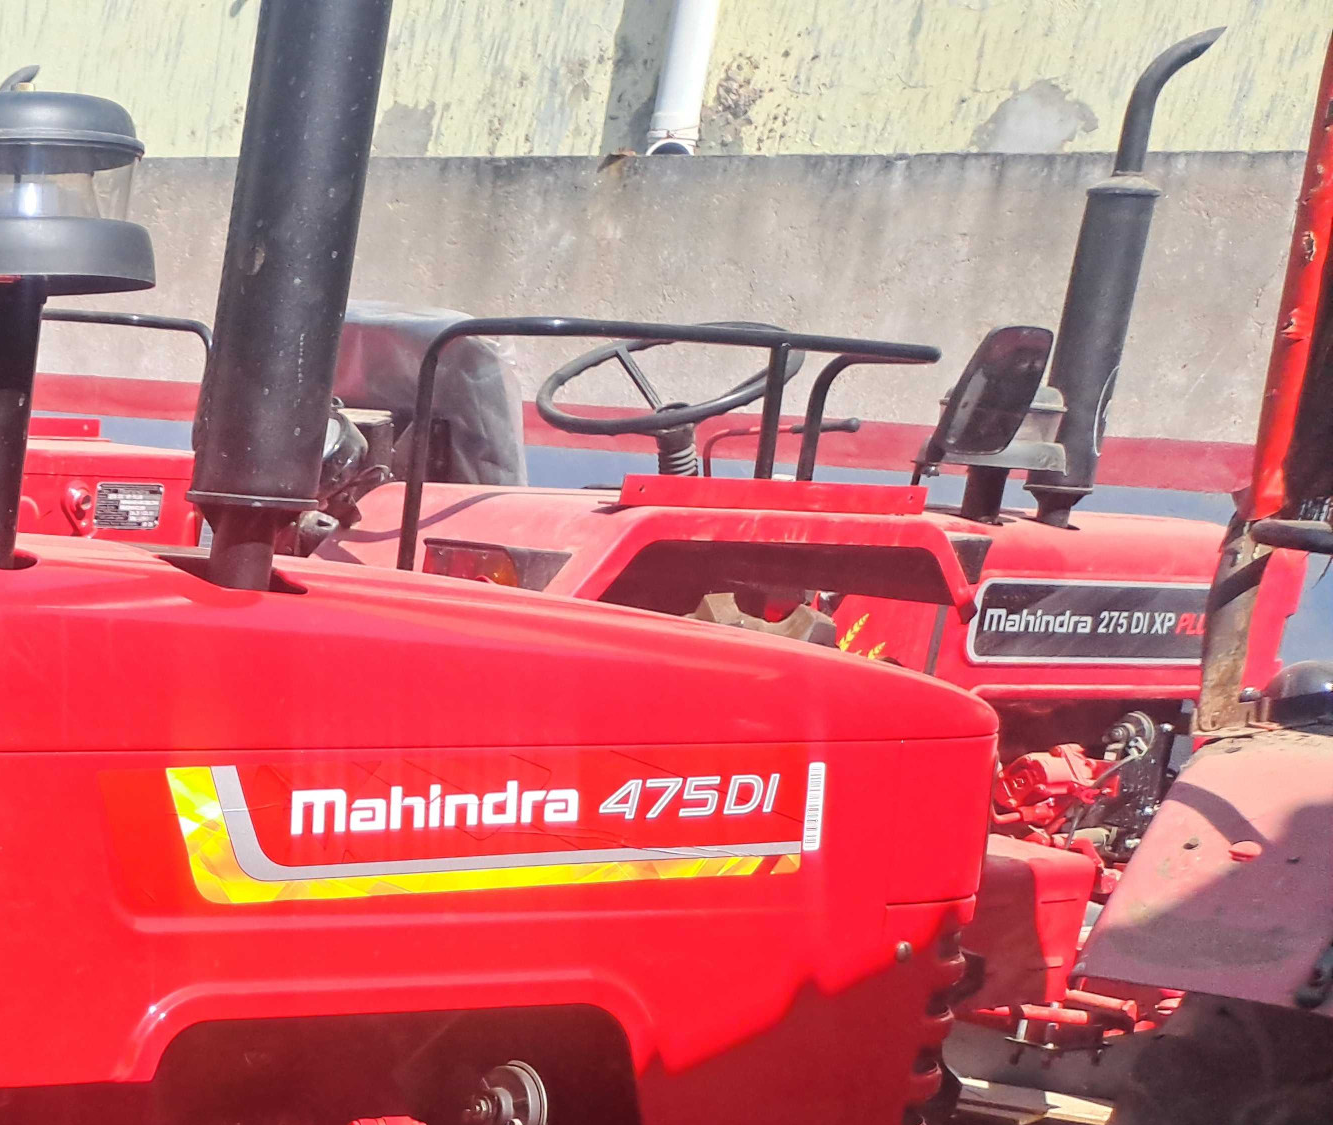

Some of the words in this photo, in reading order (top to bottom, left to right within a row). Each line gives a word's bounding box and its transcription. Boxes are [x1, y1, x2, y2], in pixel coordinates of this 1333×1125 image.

[1097, 611, 1130, 634] 275
[1130, 612, 1150, 634] DI
[1150, 612, 1177, 635] XP
[290, 779, 579, 835] Mahindra
